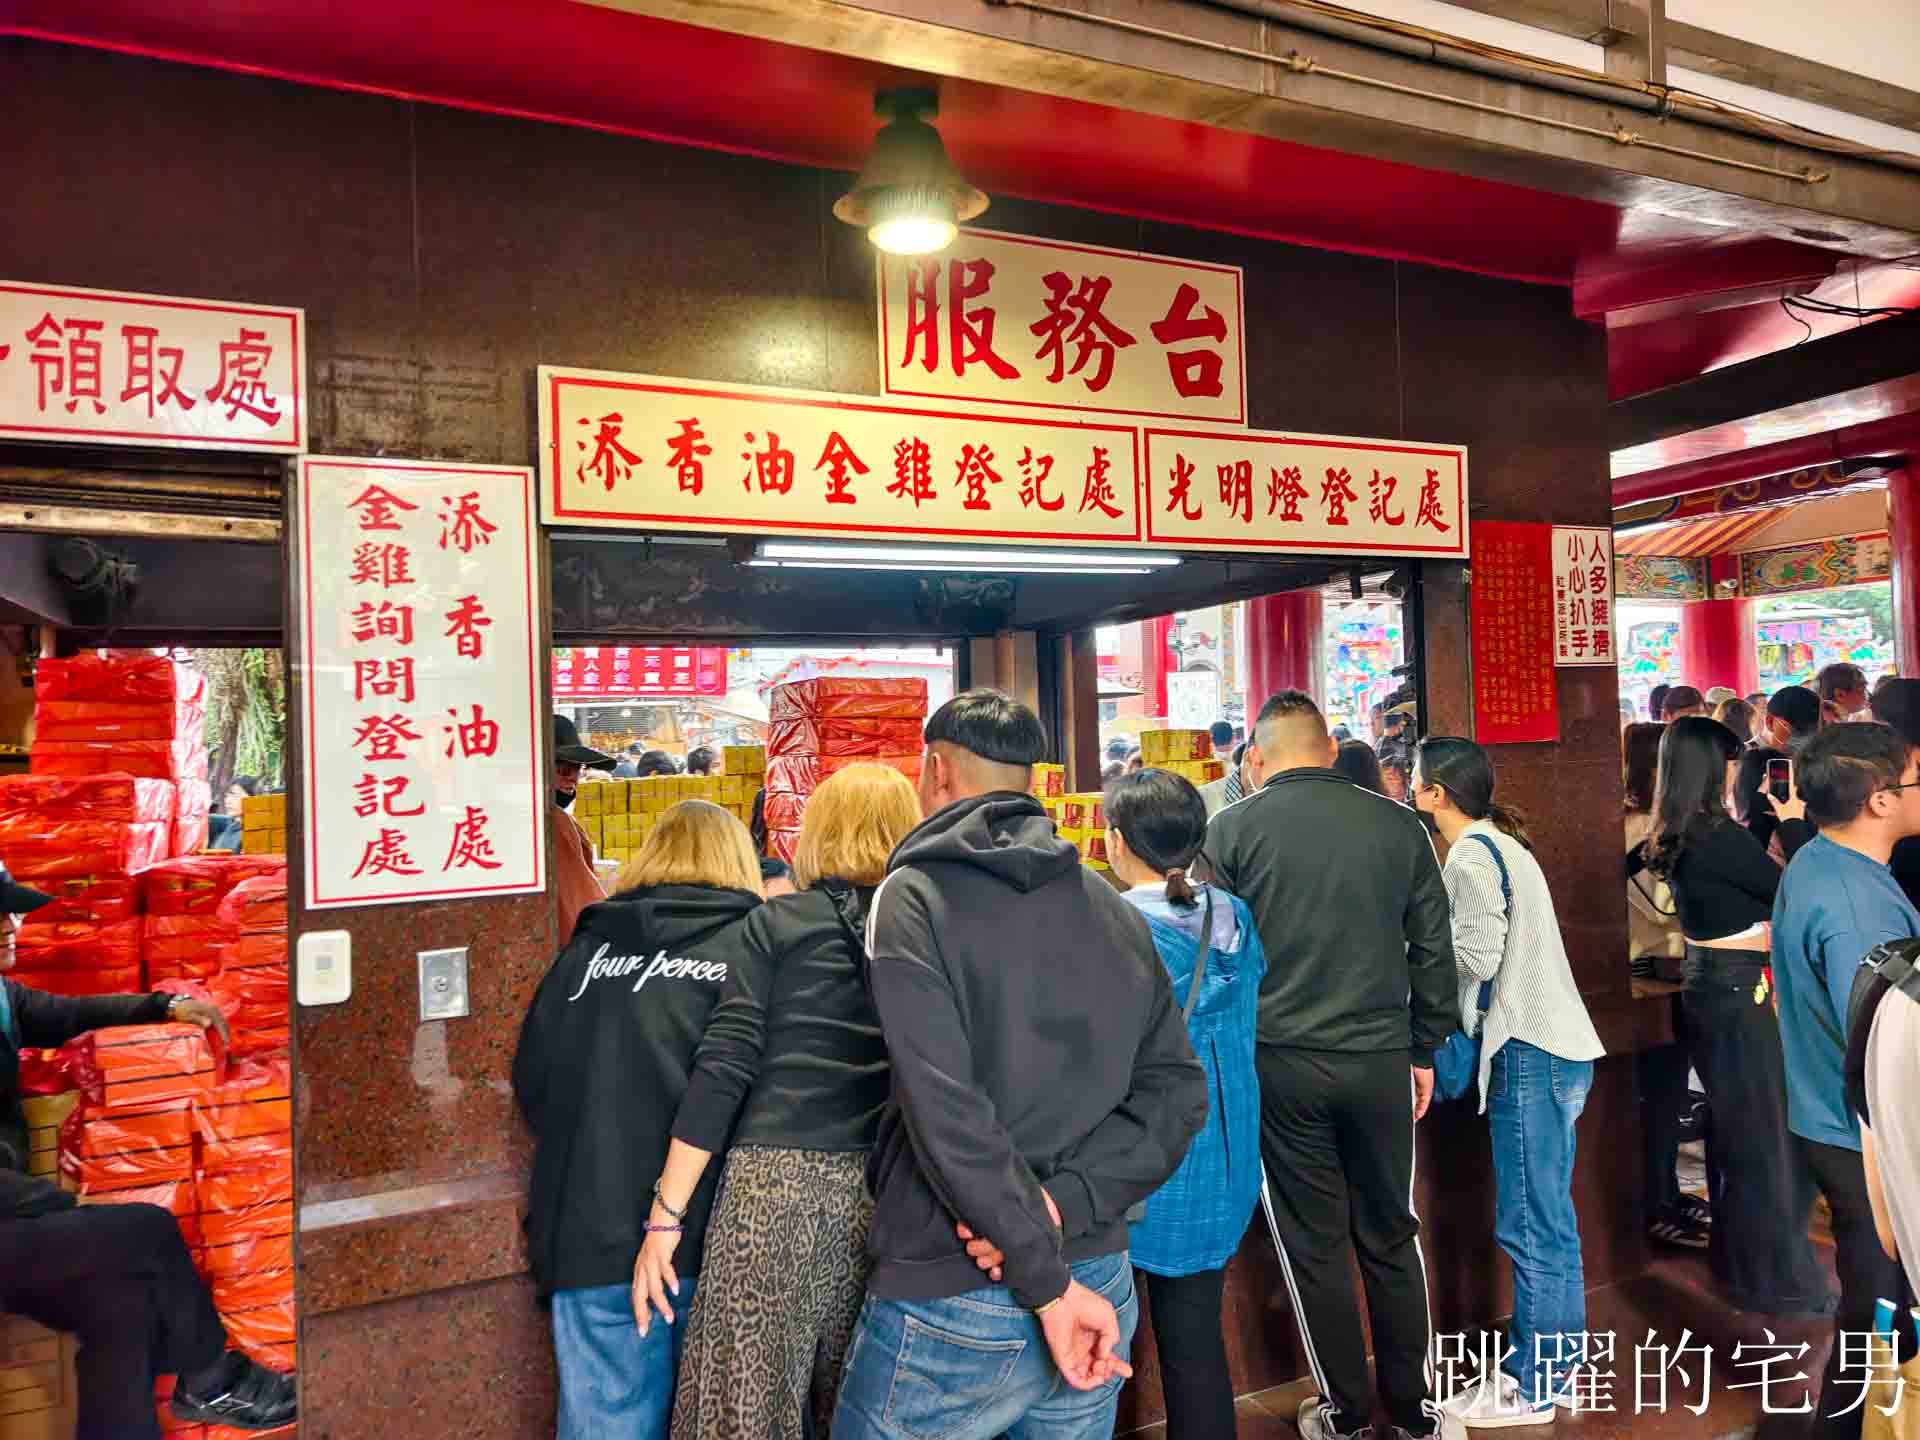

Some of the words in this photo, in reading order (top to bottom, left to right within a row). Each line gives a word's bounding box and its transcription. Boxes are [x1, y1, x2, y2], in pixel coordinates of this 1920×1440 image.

[0, 311, 281, 427] 領取處
[901, 257, 1228, 399] 服務台
[575, 412, 1125, 519] 添香油金雞登記處
[1166, 454, 1451, 535] 光明燈登記處
[1567, 533, 1589, 657] 小心扒手
[346, 483, 425, 881] 金雞詢問登記處
[437, 491, 503, 871] 添香油處
[568, 942, 645, 1001] four
